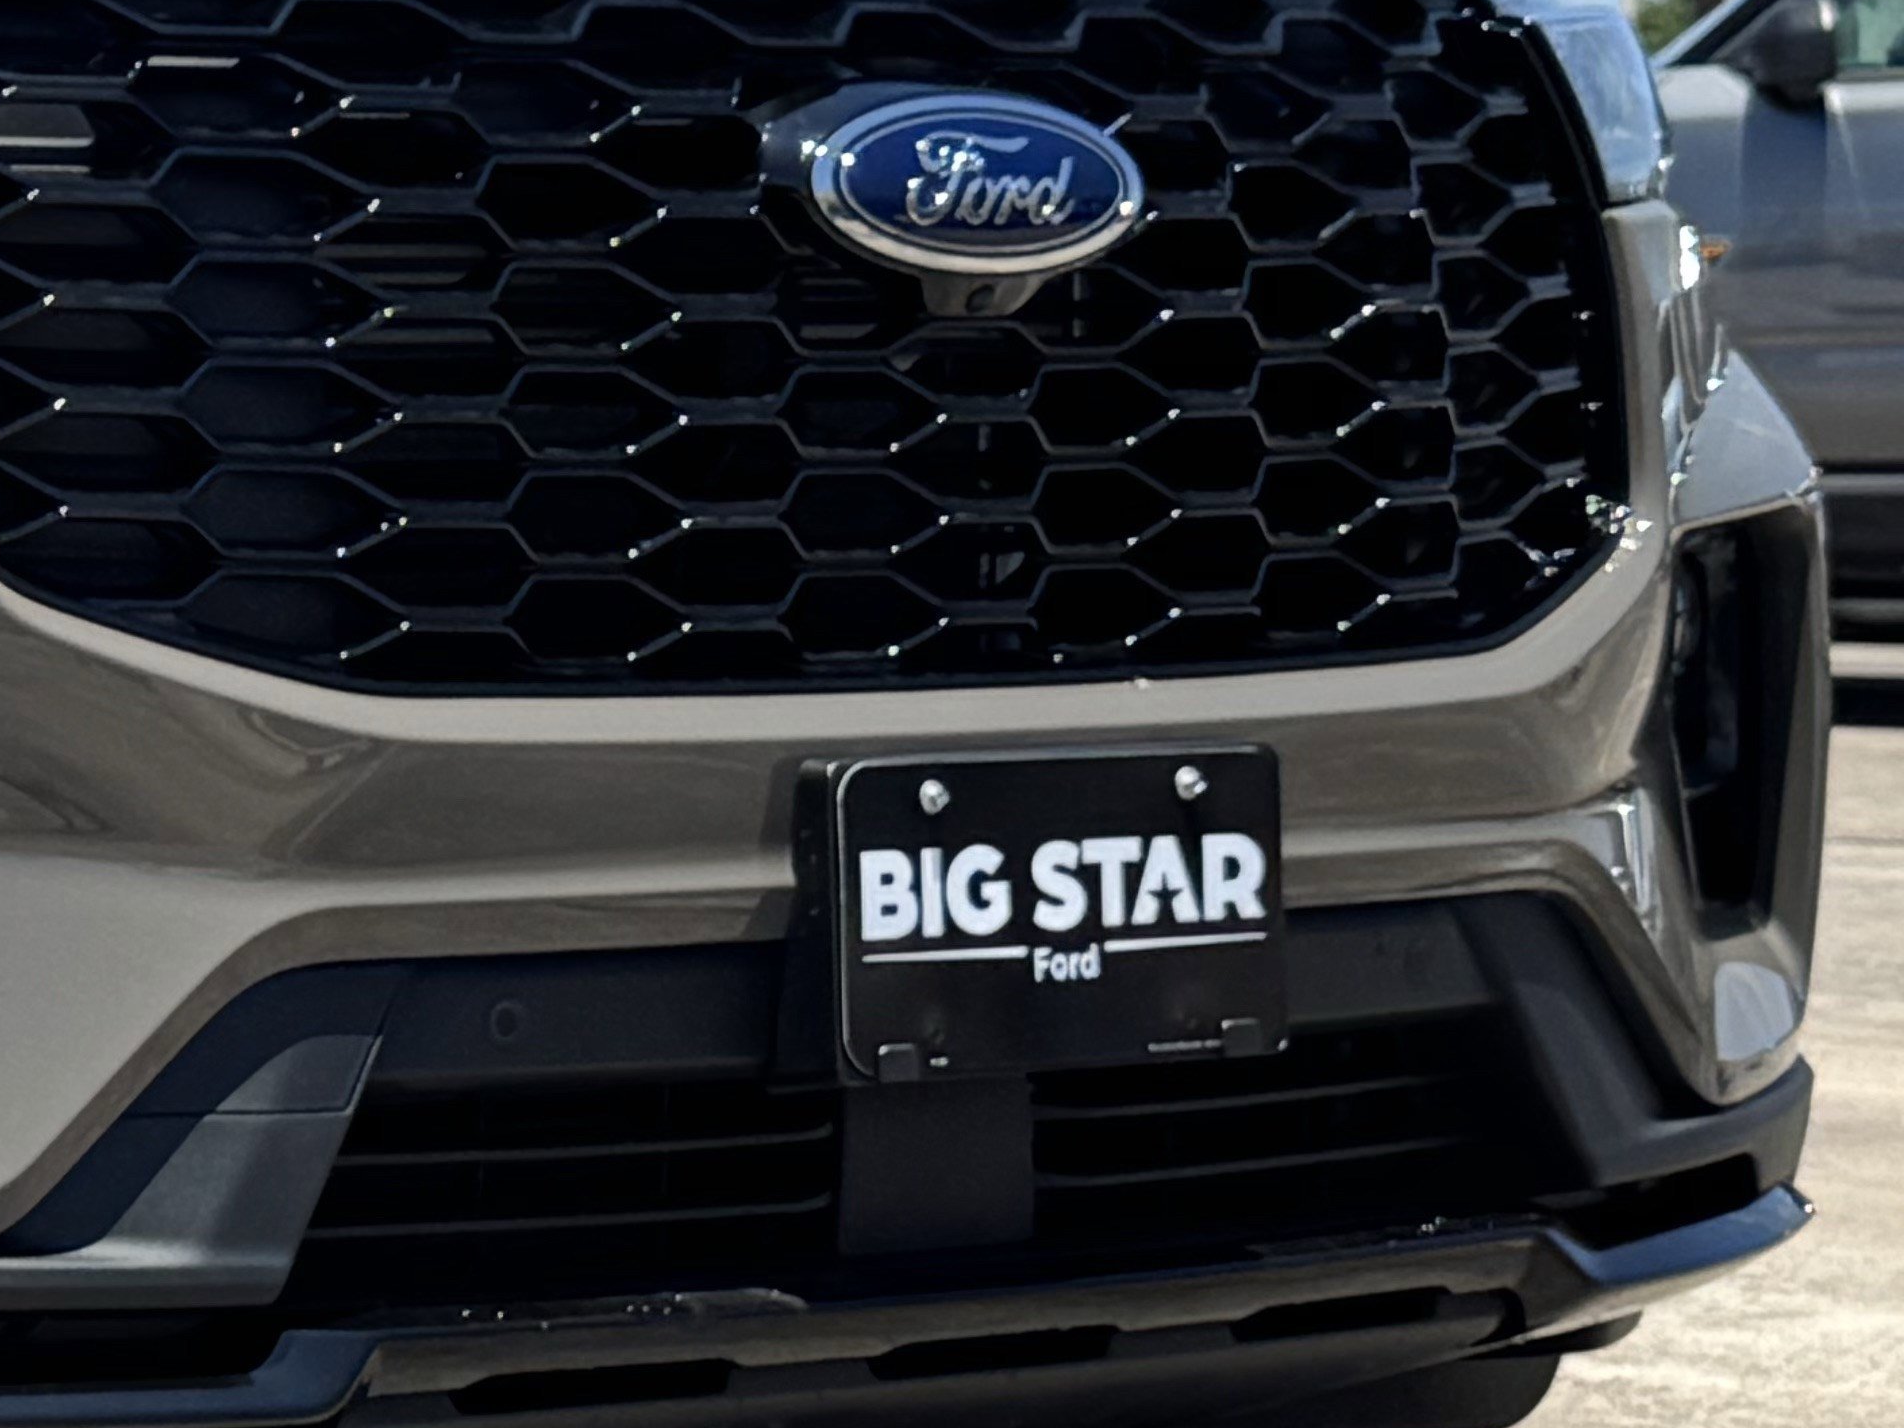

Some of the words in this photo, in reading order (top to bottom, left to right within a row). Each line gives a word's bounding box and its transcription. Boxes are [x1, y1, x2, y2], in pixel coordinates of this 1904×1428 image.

[905, 130, 1075, 225] Ford
[859, 844, 1013, 941] BIG
[1031, 833, 1267, 932] STAR
[1033, 943, 1102, 983] Ford
